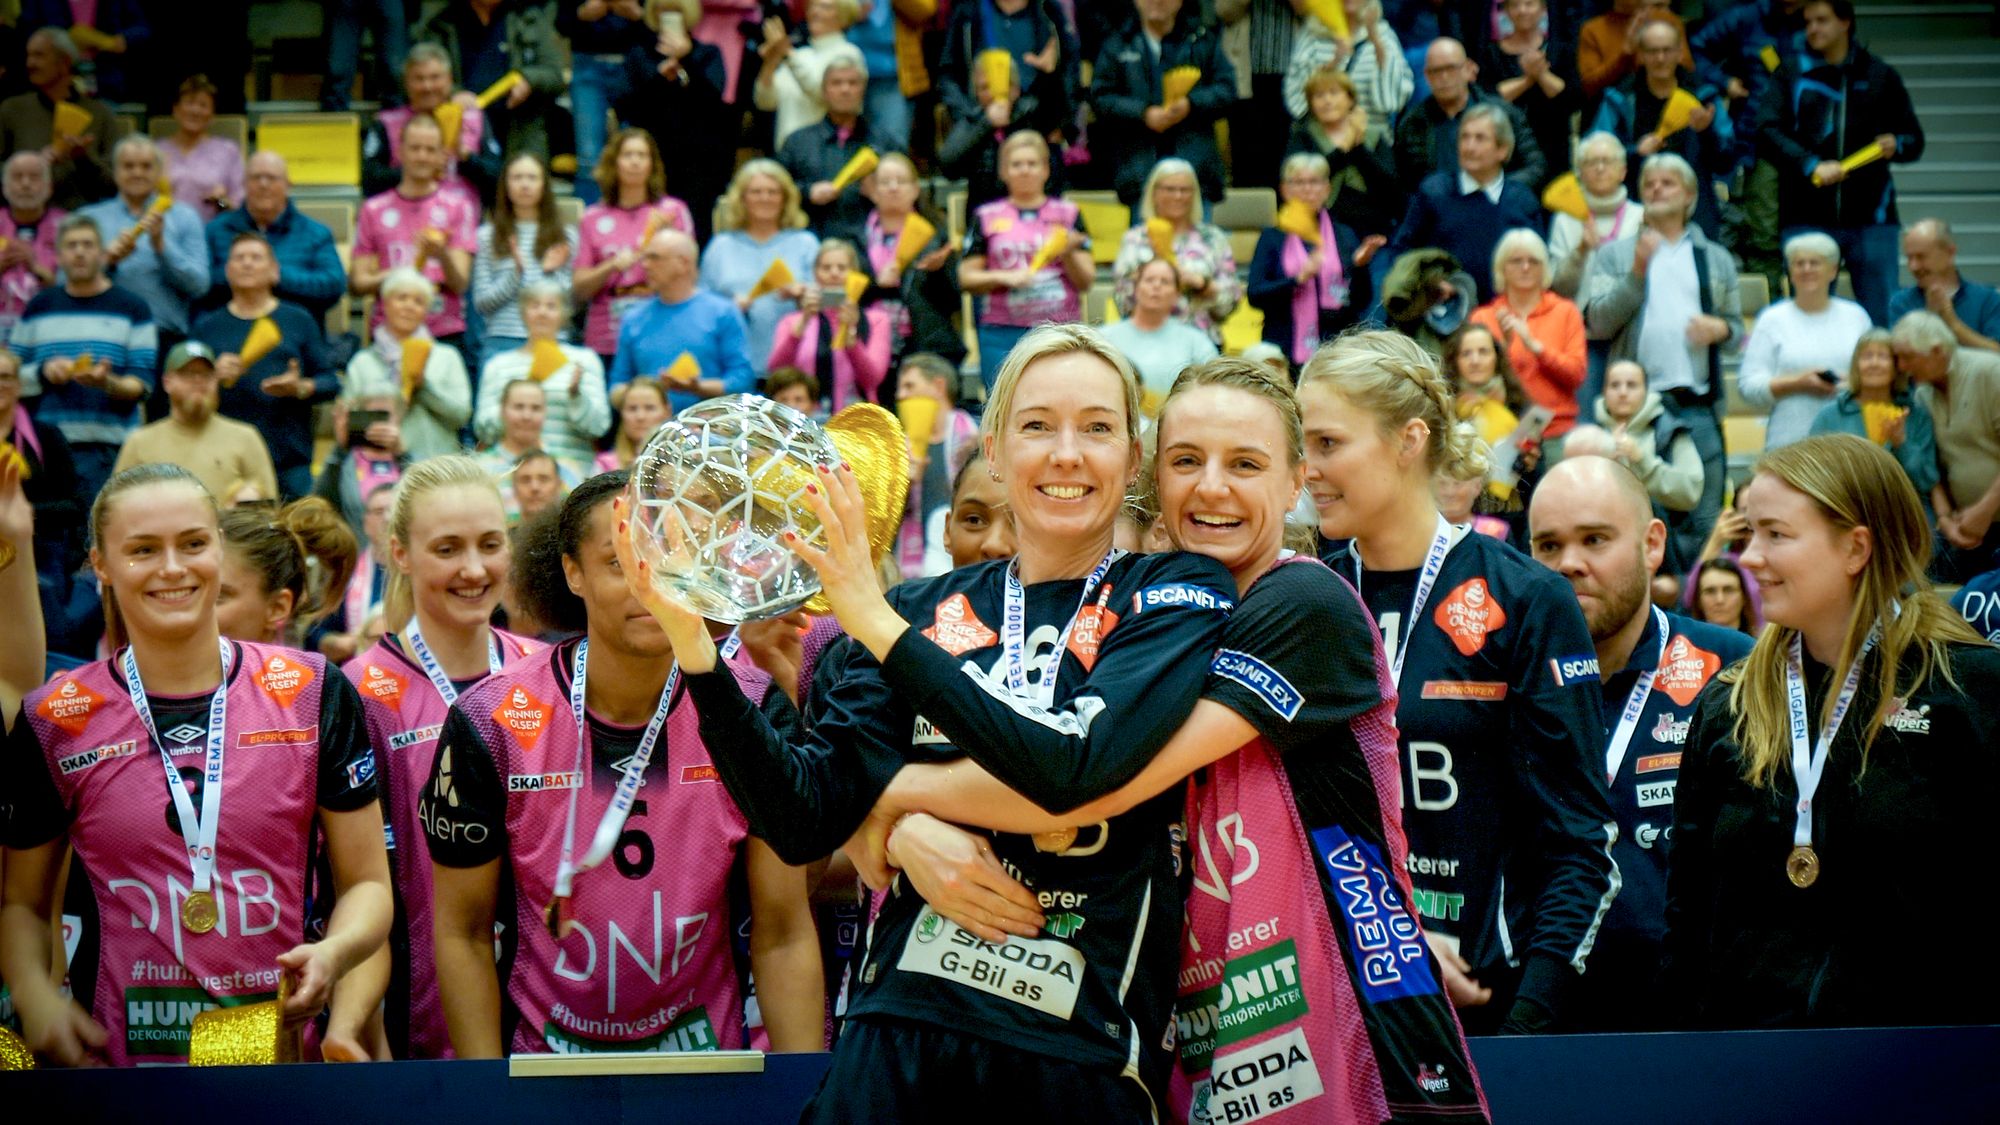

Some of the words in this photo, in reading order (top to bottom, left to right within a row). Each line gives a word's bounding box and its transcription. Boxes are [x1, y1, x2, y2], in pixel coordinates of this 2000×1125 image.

[1425, 534, 1448, 577] REMA
[1074, 616, 1103, 631] HEN
[1449, 613, 1487, 634] OLSEN
[261, 670, 301, 684] HENNIG
[411, 632, 435, 673] REMA
[431, 670, 456, 701] 1000
[1009, 643, 1024, 690] REMA
[1657, 659, 1705, 678] HENNIG
[1661, 669, 1703, 686] OLSEN
[265, 679, 299, 692] OLSEN
[1215, 656, 1293, 710] SCANFLEX
[48, 696, 92, 710] HENNIG
[53, 704, 90, 718] OLSEN
[503, 709, 543, 720] HENNIG
[1625, 683, 1648, 722] REMA
[510, 718, 541, 731] OLSEN
[914, 722, 940, 737] AN
[1884, 717, 1931, 733] Vipers
[169, 745, 203, 757] umbro
[616, 764, 641, 812] REMA
[637, 666, 678, 763] 1000-LIGAEN
[59, 742, 134, 773] SKANBATT
[208, 737, 222, 783] REMA
[1648, 758, 1681, 769] EL-PRO
[418, 799, 489, 844] Alero
[612, 799, 655, 881] 6
[1404, 852, 1460, 878] terer
[108, 867, 281, 964] DNB
[1328, 840, 1402, 987] REMA
[1413, 889, 1465, 922] NIT
[940, 951, 1008, 989] G-Bil
[1011, 977, 1044, 1002] as
[1218, 988, 1302, 1031] ERIØRPLATER
[128, 1030, 191, 1041] DEKORATIV
[1210, 1044, 1309, 1096] KODA
[1267, 1085, 1295, 1108] as
[1421, 1078, 1450, 1093] Vipers
